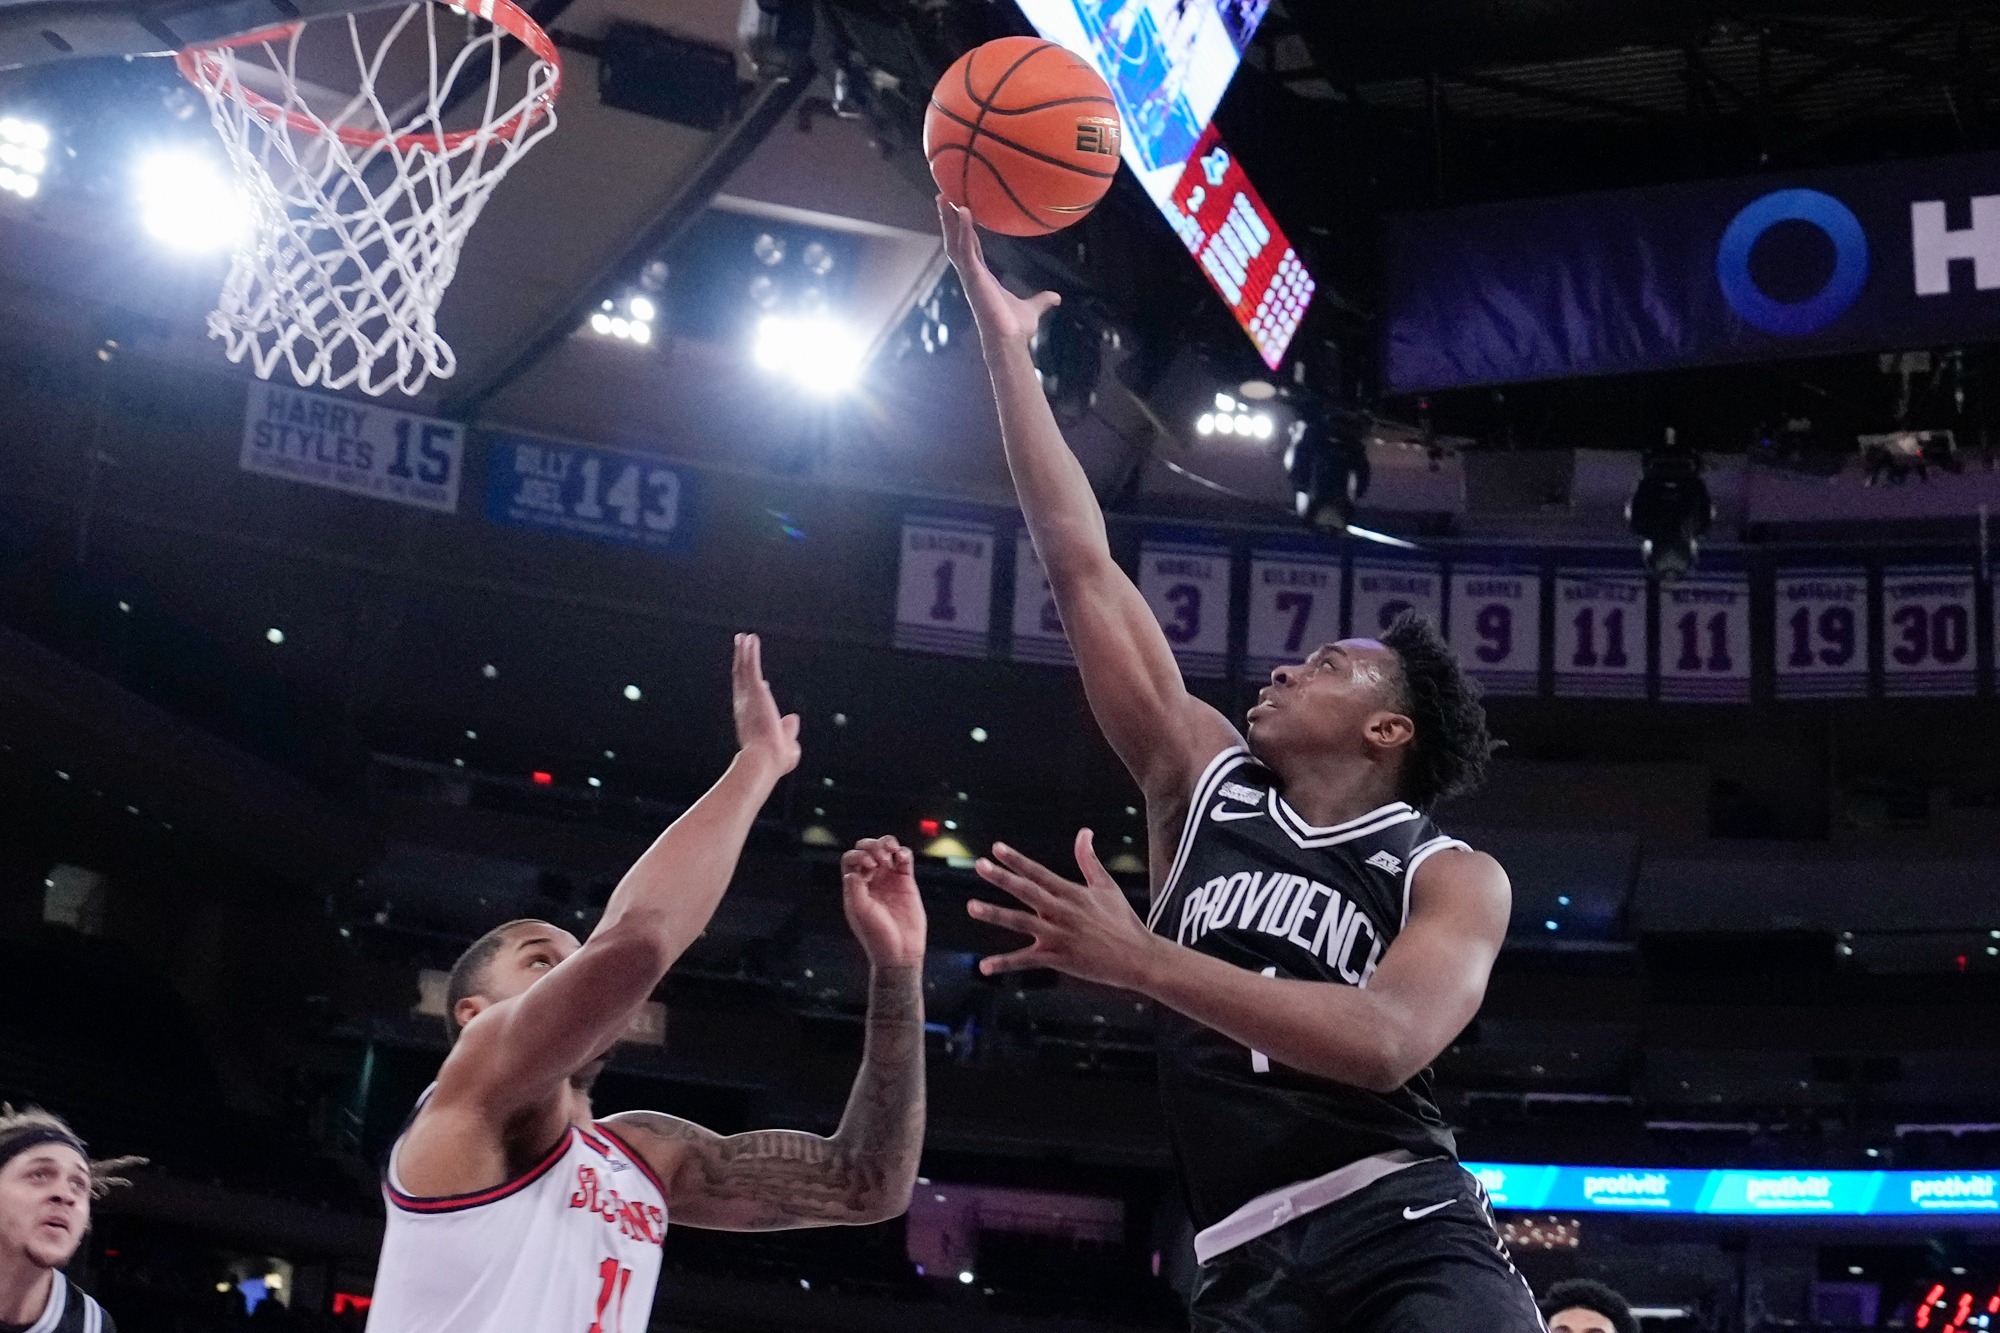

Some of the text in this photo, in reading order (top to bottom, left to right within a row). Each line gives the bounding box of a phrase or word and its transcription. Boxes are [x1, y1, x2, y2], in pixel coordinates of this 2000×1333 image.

[1911, 195, 2000, 296] H
[266, 389, 368, 437] HARRY
[253, 418, 374, 470] STYLES
[387, 417, 455, 486] 15
[573, 457, 680, 531] 143
[930, 560, 957, 621] 1
[1164, 582, 1201, 643] 3
[1276, 590, 1314, 652] 7
[1474, 603, 1512, 663] 9
[1572, 606, 1628, 667] 11
[1677, 610, 1732, 672] 11
[1788, 605, 1856, 667] 19
[1892, 603, 1969, 665] 30
[1583, 1173, 1670, 1199] protiviti
[1746, 1176, 1833, 1202] protiviti
[1911, 1175, 1998, 1203] protiviti
